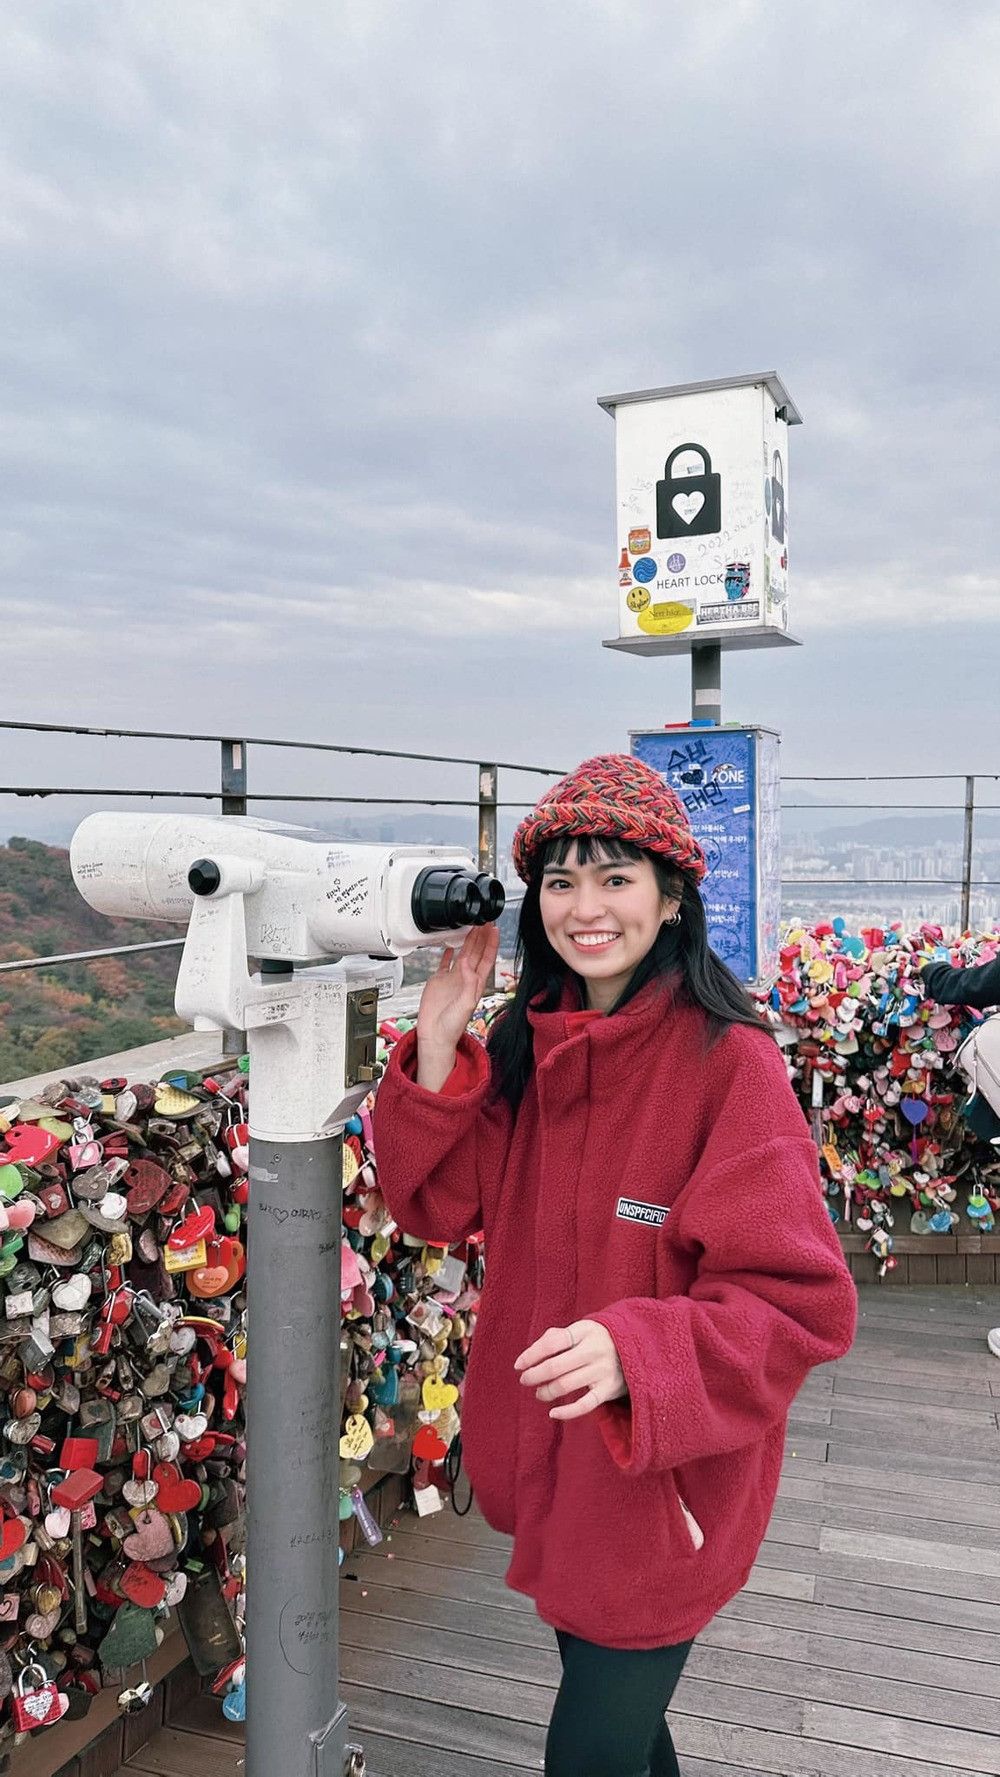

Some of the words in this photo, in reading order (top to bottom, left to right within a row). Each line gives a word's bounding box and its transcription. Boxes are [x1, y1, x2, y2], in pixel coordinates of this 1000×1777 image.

[656, 576, 691, 590] HEART
[694, 573, 724, 586] LOCK
[701, 604, 739, 617] HERTHA
[741, 602, 759, 613] BSC
[683, 779, 728, 814] 태민
